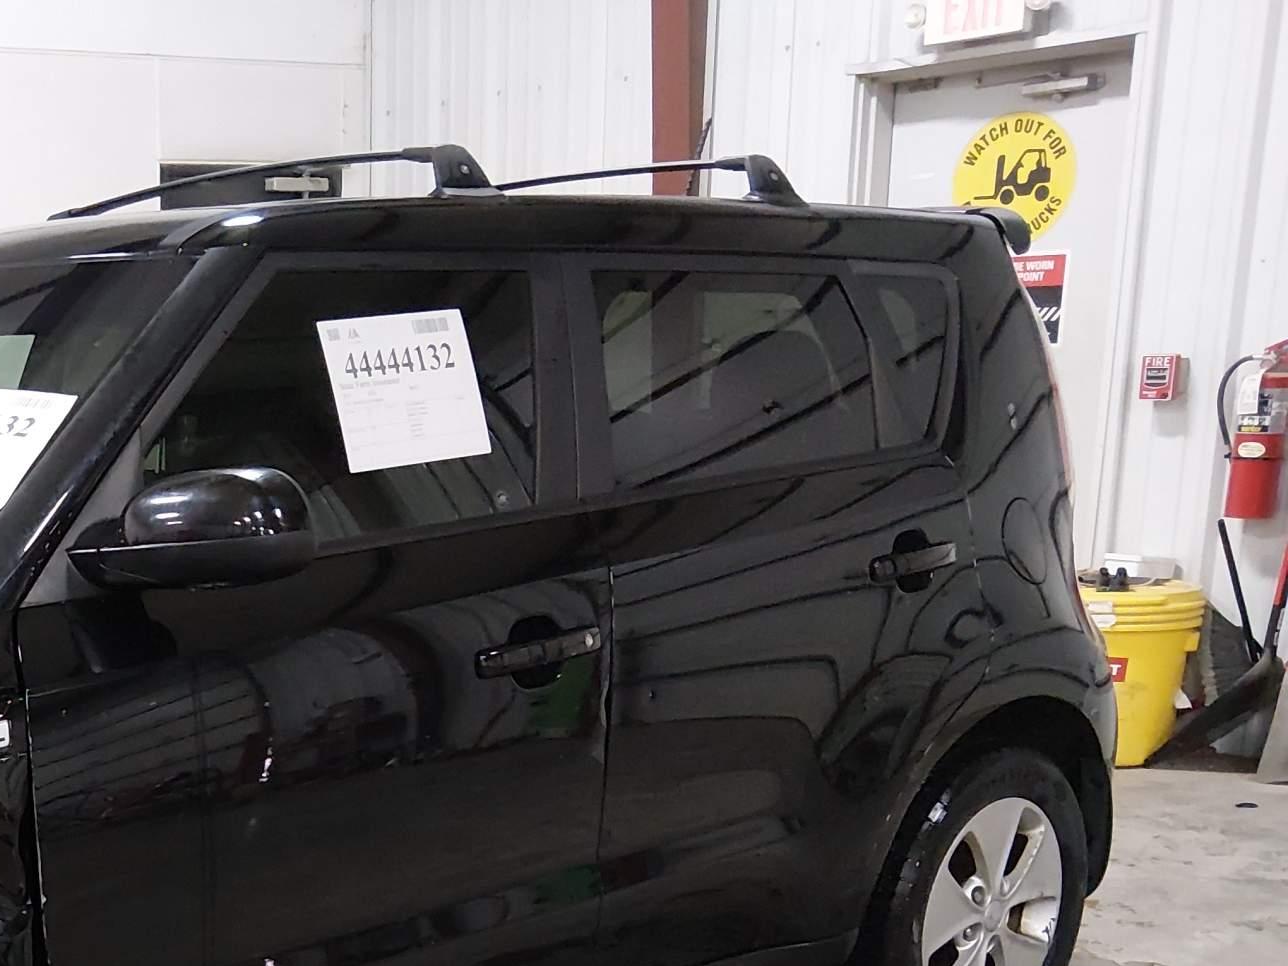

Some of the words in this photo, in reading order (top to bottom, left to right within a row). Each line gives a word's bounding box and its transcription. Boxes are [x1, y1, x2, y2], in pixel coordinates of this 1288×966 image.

[963, 121, 1009, 167] WATCH
[1014, 118, 1044, 136] OUT
[1043, 128, 1067, 160] FOR
[1029, 196, 1062, 231] UCKS
[1026, 259, 1055, 270] WORN
[345, 342, 455, 379] 44444132
[1145, 356, 1171, 367] FIRE
